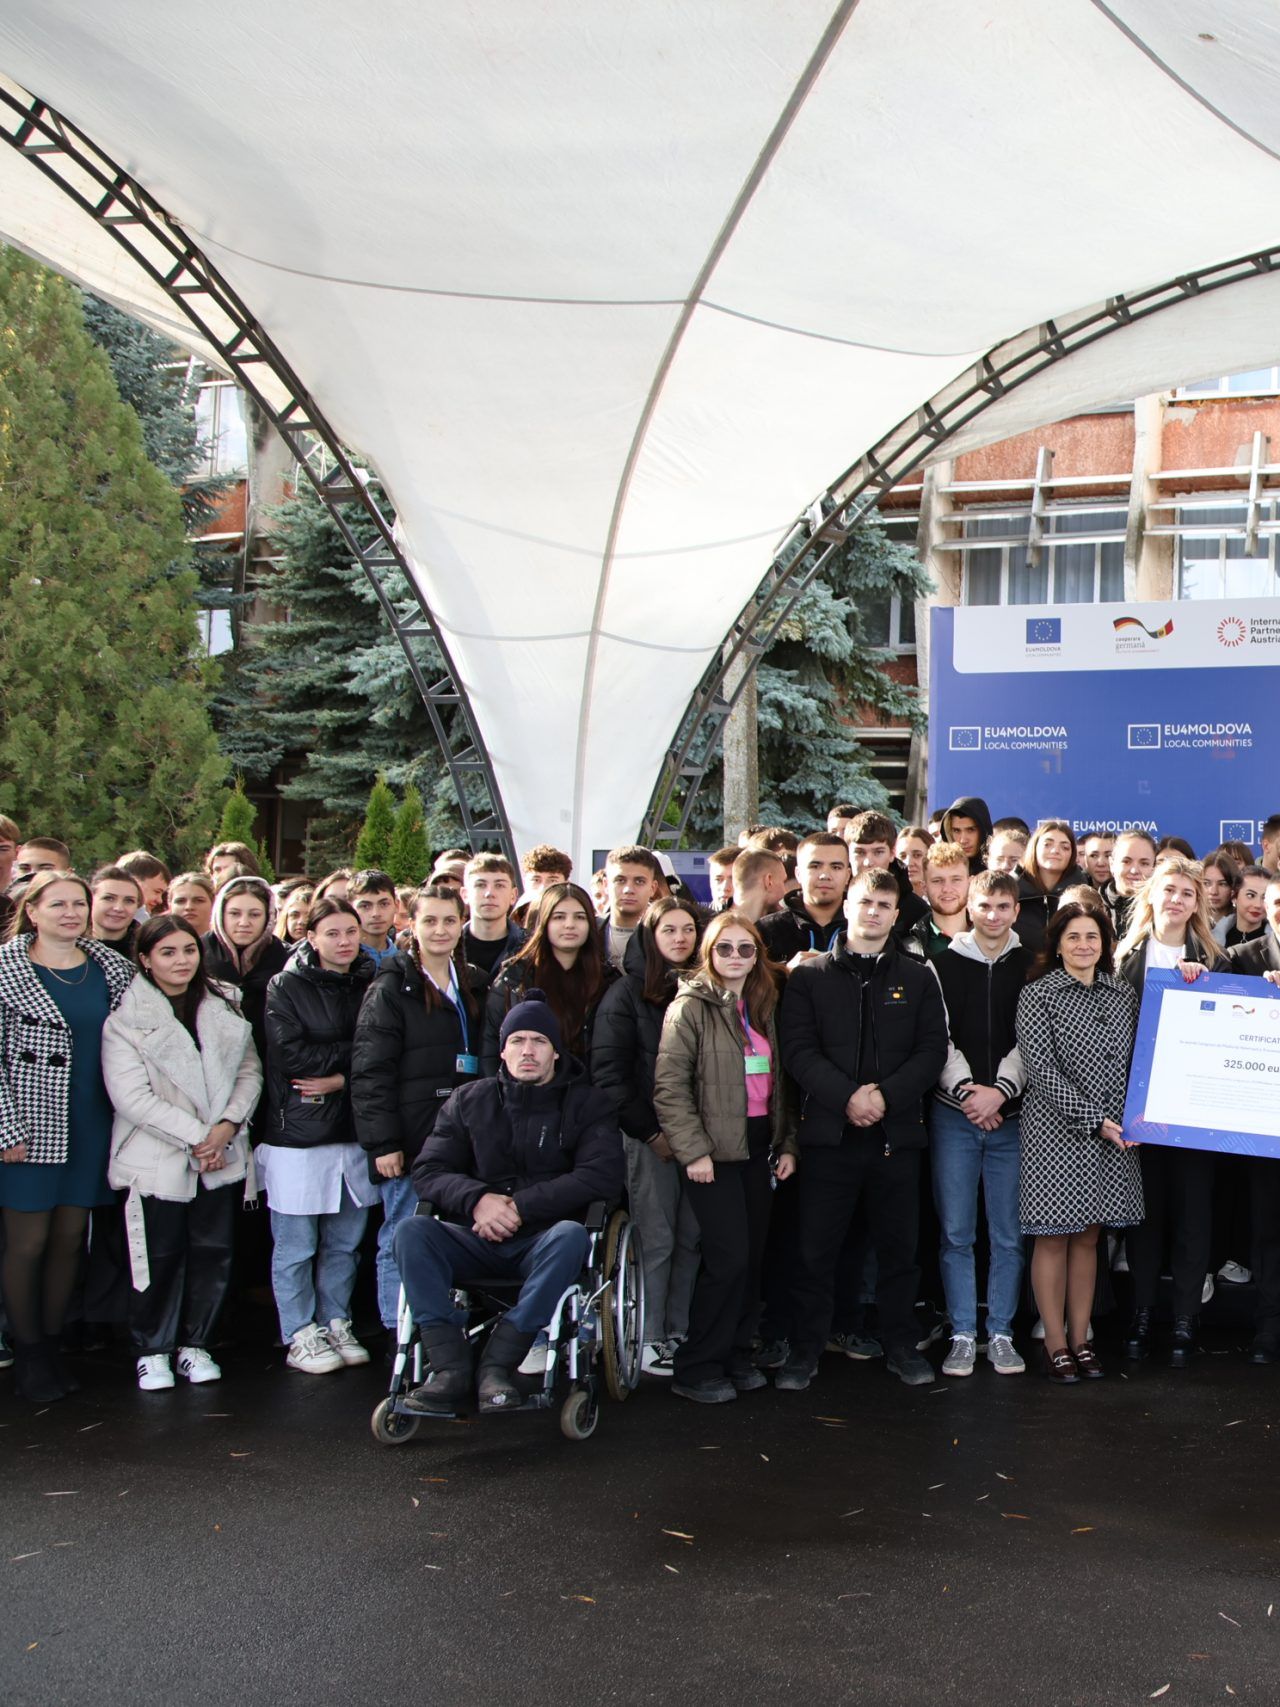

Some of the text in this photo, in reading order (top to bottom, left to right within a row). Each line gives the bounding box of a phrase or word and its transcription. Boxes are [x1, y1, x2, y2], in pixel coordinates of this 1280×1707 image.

[984, 725, 1068, 739] EU4MOLDOVA
[1164, 722, 1253, 737] EU4MOLDOVA
[984, 741, 1068, 751] LOCAL COMMUNITIES
[1164, 738, 1253, 750] LOCAL COMMUNITIES
[1239, 1033, 1280, 1045] CERTIFICAT
[1223, 1059, 1266, 1072] 325.000
